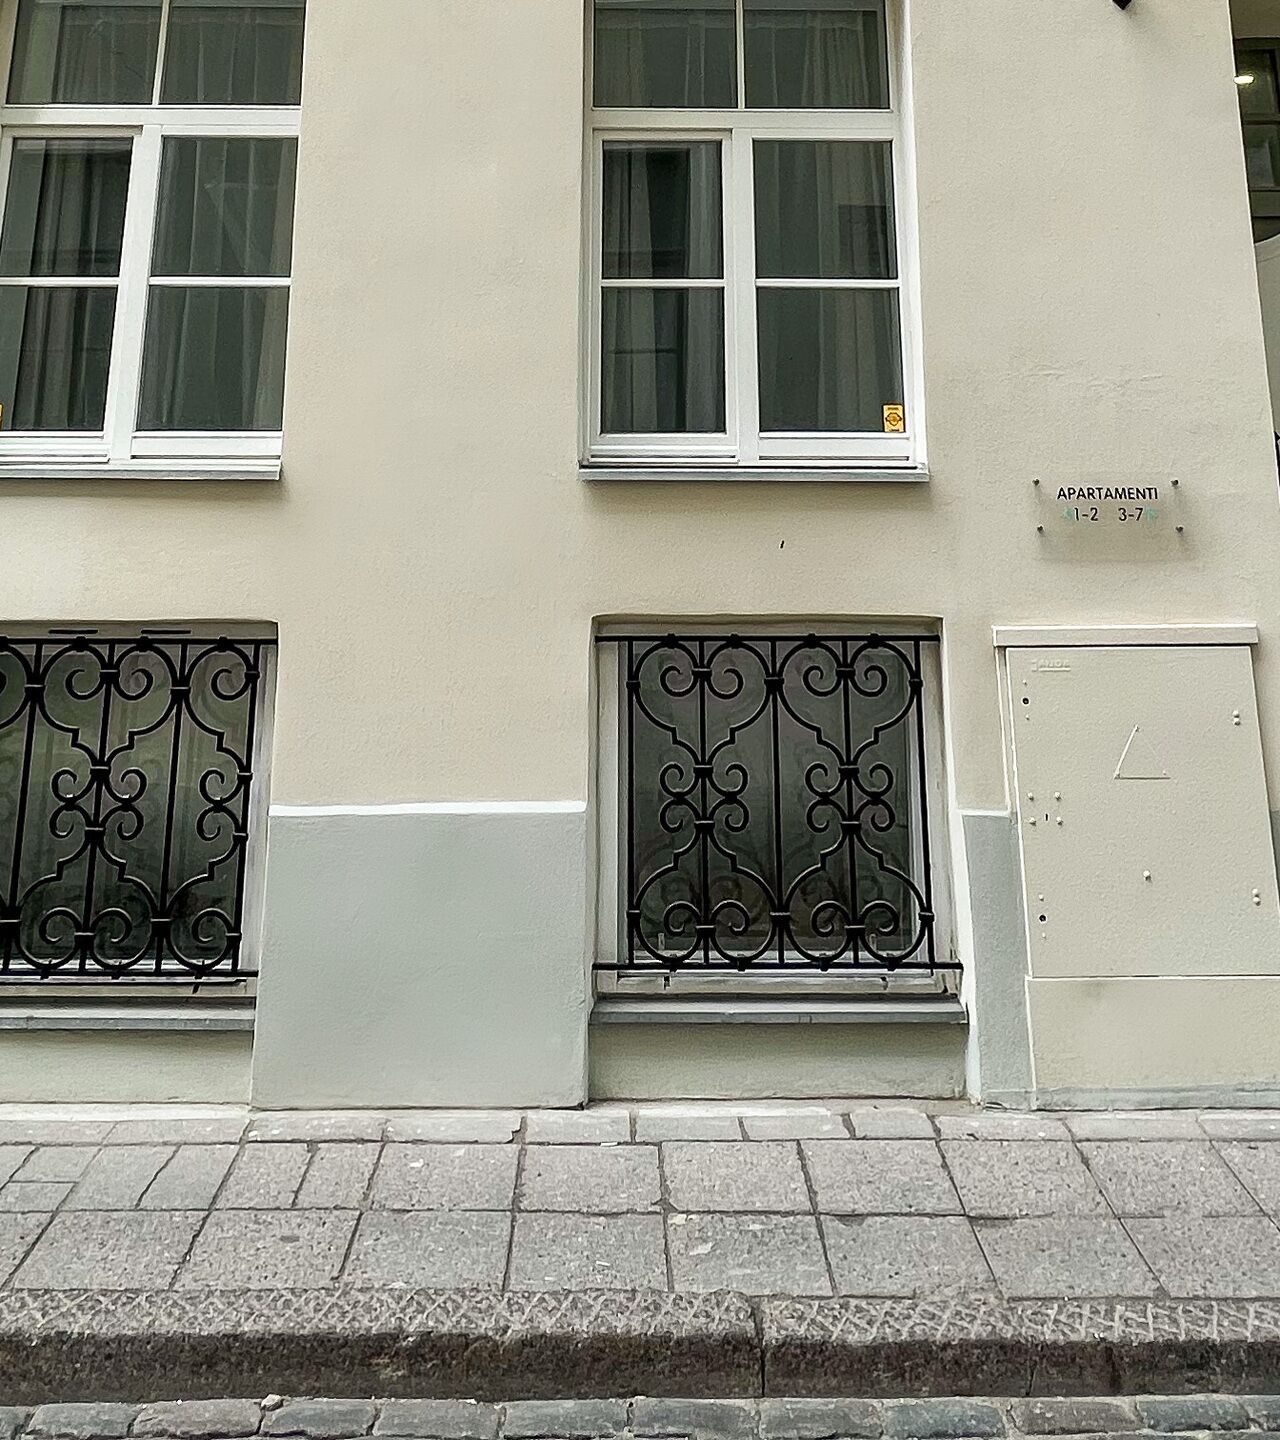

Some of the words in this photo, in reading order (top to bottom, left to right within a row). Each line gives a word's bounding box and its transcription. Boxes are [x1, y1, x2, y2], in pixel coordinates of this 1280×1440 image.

[1056, 487, 1158, 500] APARTAMENTI
[1074, 507, 1098, 522] 1-2
[1117, 507, 1144, 522] 3-7
